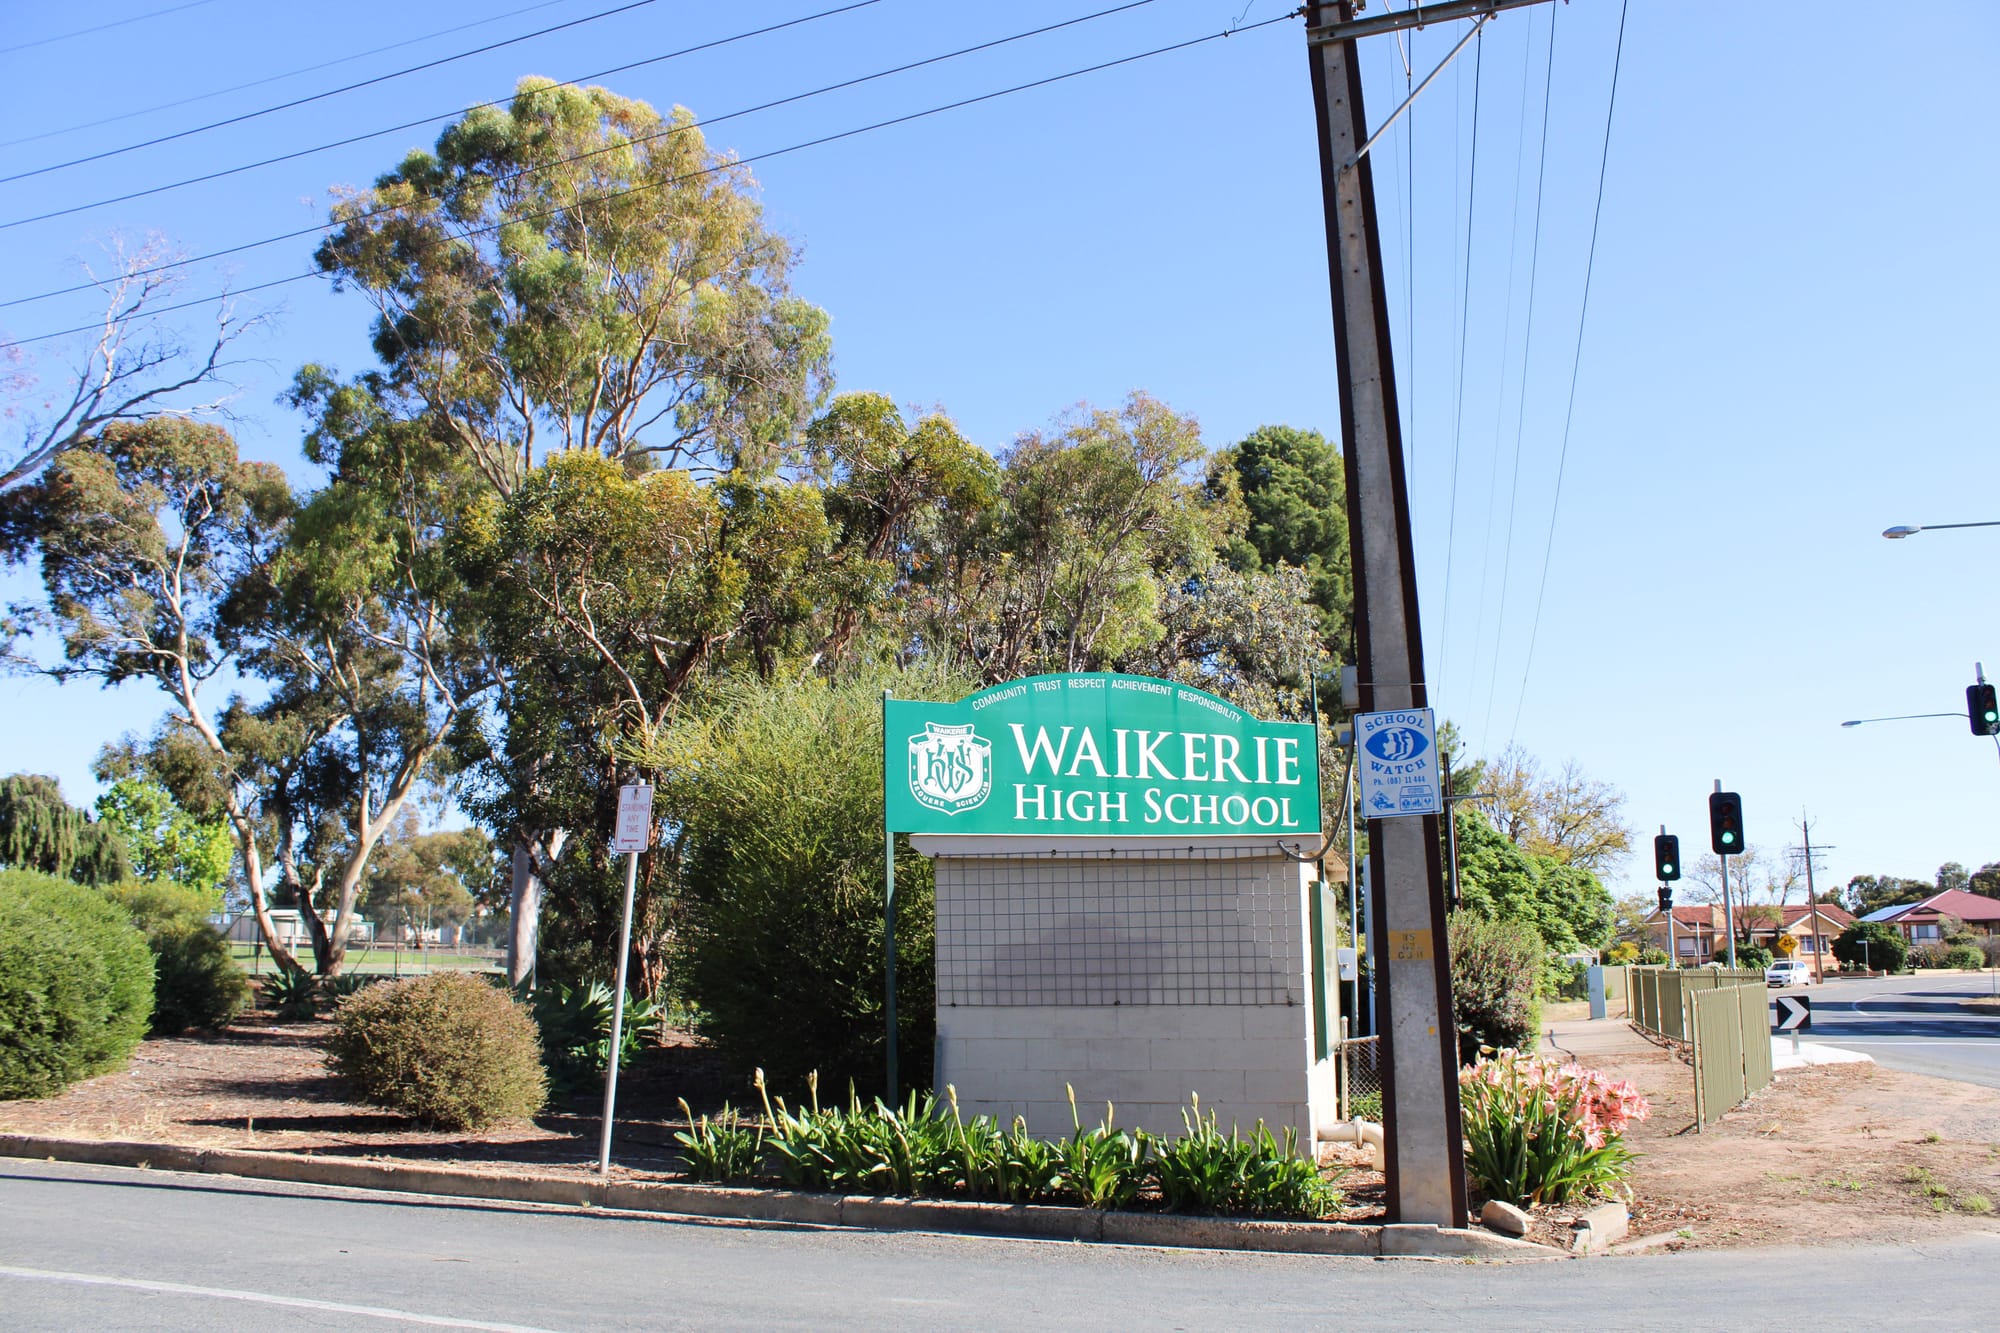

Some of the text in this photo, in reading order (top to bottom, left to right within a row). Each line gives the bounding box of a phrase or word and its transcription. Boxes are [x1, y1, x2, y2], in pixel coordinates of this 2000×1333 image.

[972, 678, 1242, 723] COMMUNITY TRUST RESPECT ACHIEVEMENT RESPONSIBILITY
[932, 726, 968, 735] WAIKERIE
[1364, 713, 1426, 732] SCHOOL
[1008, 723, 1301, 785] WAIKERIE
[1370, 758, 1427, 775] WATCH
[1012, 783, 1299, 827] HIGH SCHOOL
[626, 824, 639, 833] TIME
